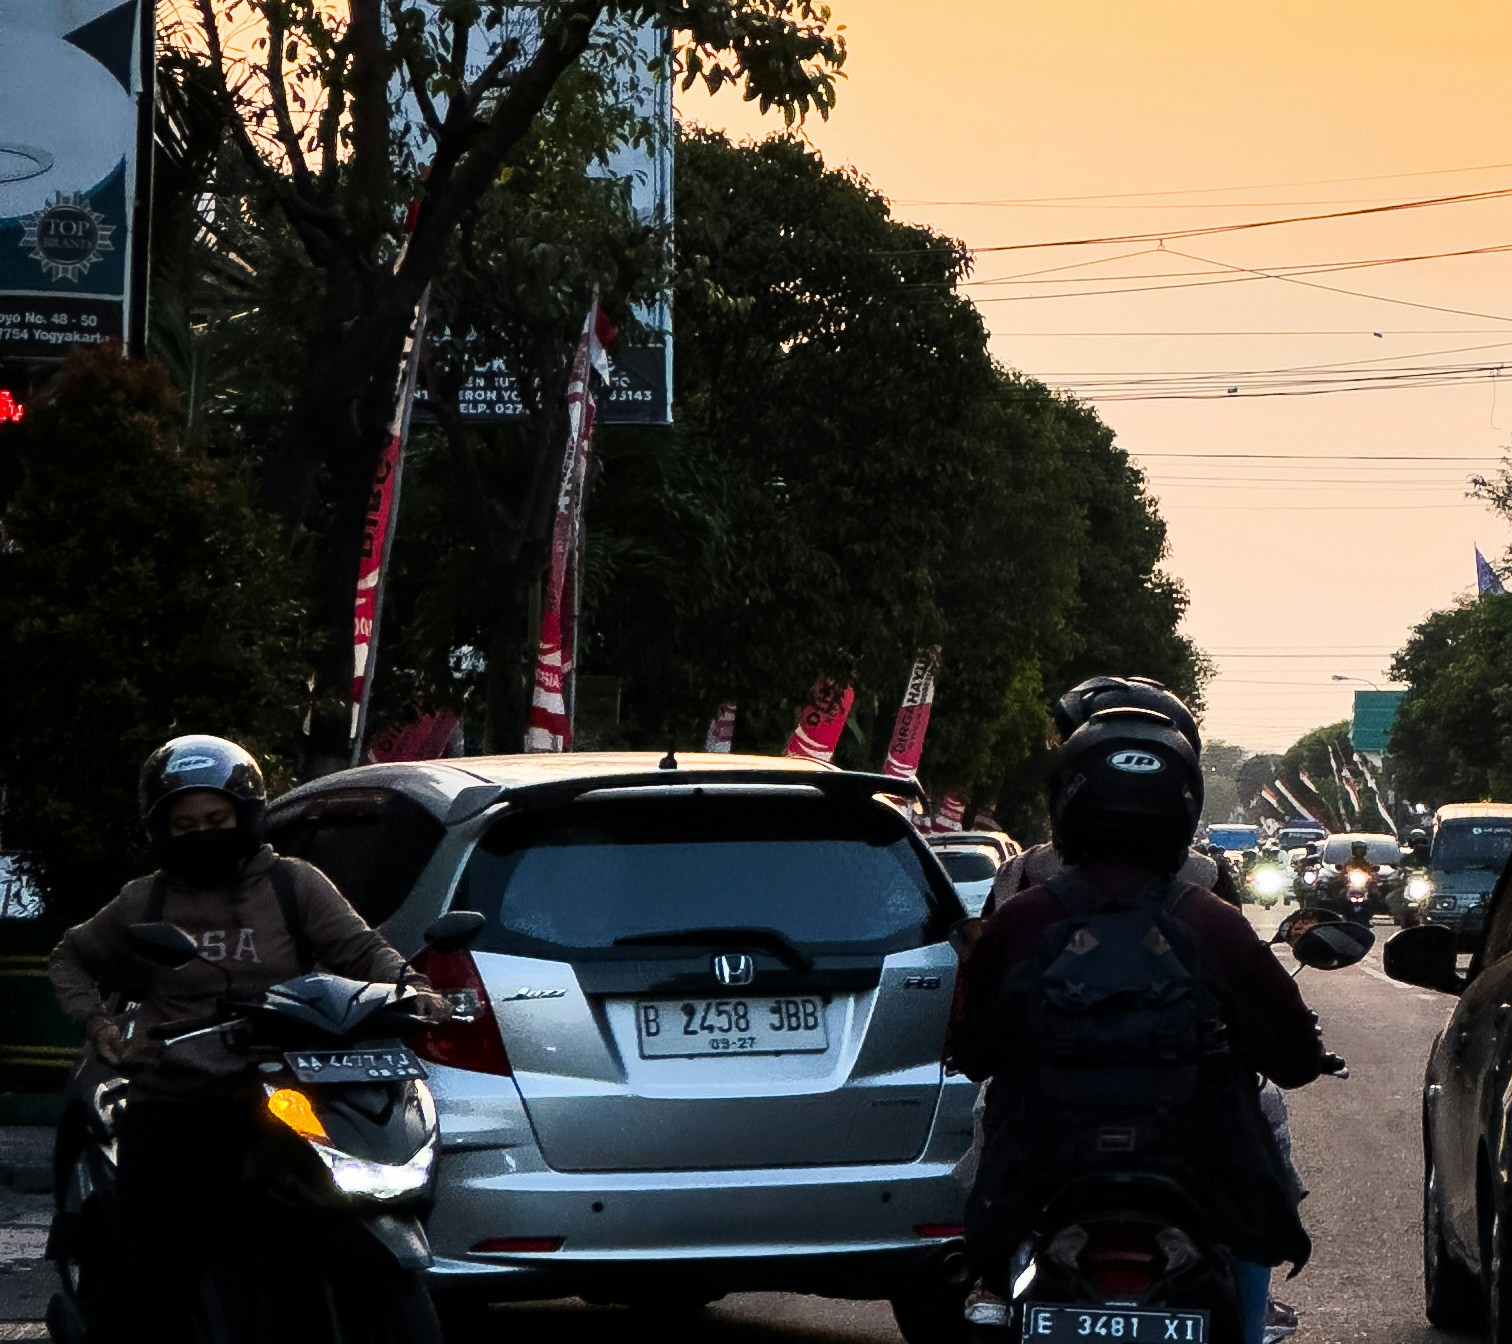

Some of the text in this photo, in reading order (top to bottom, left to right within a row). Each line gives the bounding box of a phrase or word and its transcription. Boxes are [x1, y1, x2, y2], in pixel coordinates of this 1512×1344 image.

[44, 220, 89, 236] TOP
[43, 237, 92, 249] BRAND
[51, 313, 68, 325] 48
[81, 314, 97, 326] 50
[200, 928, 262, 963] SA
[502, 987, 567, 1002] Jazz
[643, 1000, 819, 1037] B 2458 JBB
[1037, 1313, 1053, 1335] E
[1078, 1315, 1139, 1338] 3481
